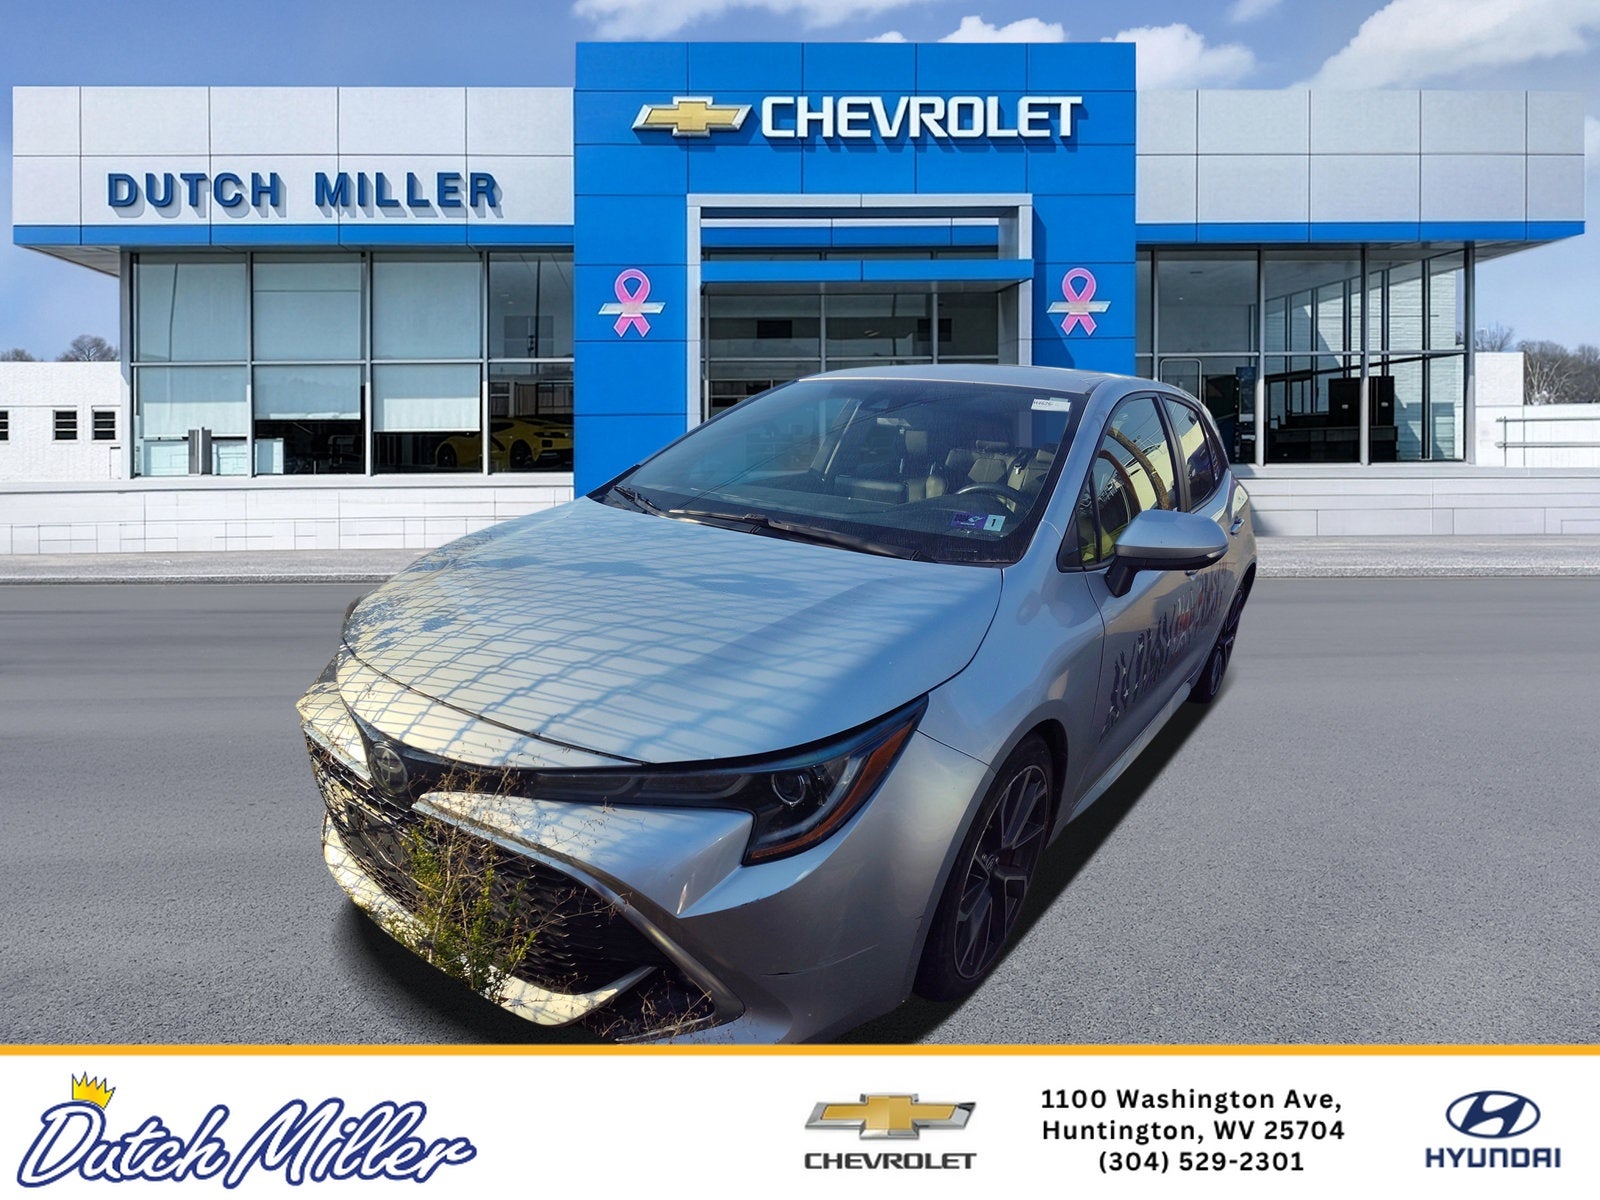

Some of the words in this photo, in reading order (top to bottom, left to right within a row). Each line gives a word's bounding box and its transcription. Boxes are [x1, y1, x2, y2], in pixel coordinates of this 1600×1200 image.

[761, 95, 1083, 139] CHEVROLET
[107, 172, 281, 208] DUTCH
[314, 172, 499, 209] MILLER
